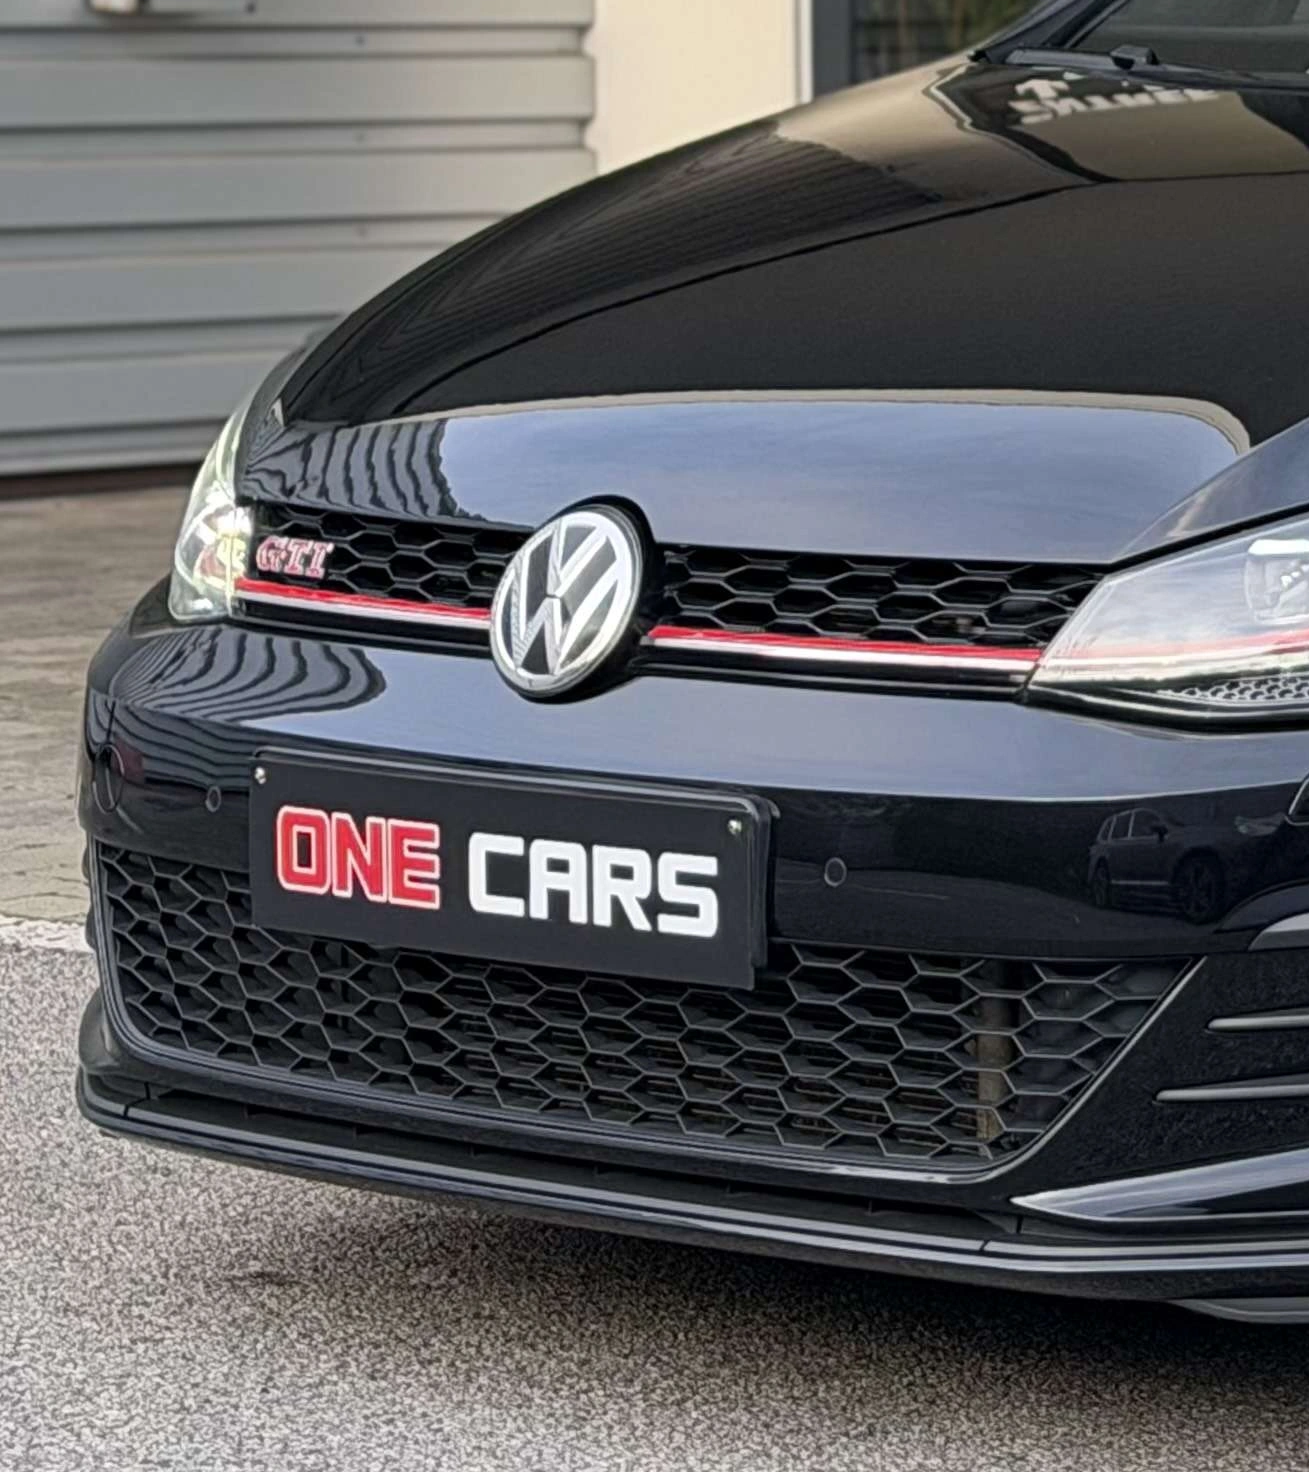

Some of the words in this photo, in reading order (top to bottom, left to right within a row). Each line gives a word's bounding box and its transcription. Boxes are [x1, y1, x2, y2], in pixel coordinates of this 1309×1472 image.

[255, 535, 334, 579] GTI
[276, 805, 441, 910] ONE
[468, 831, 719, 938] CARS
